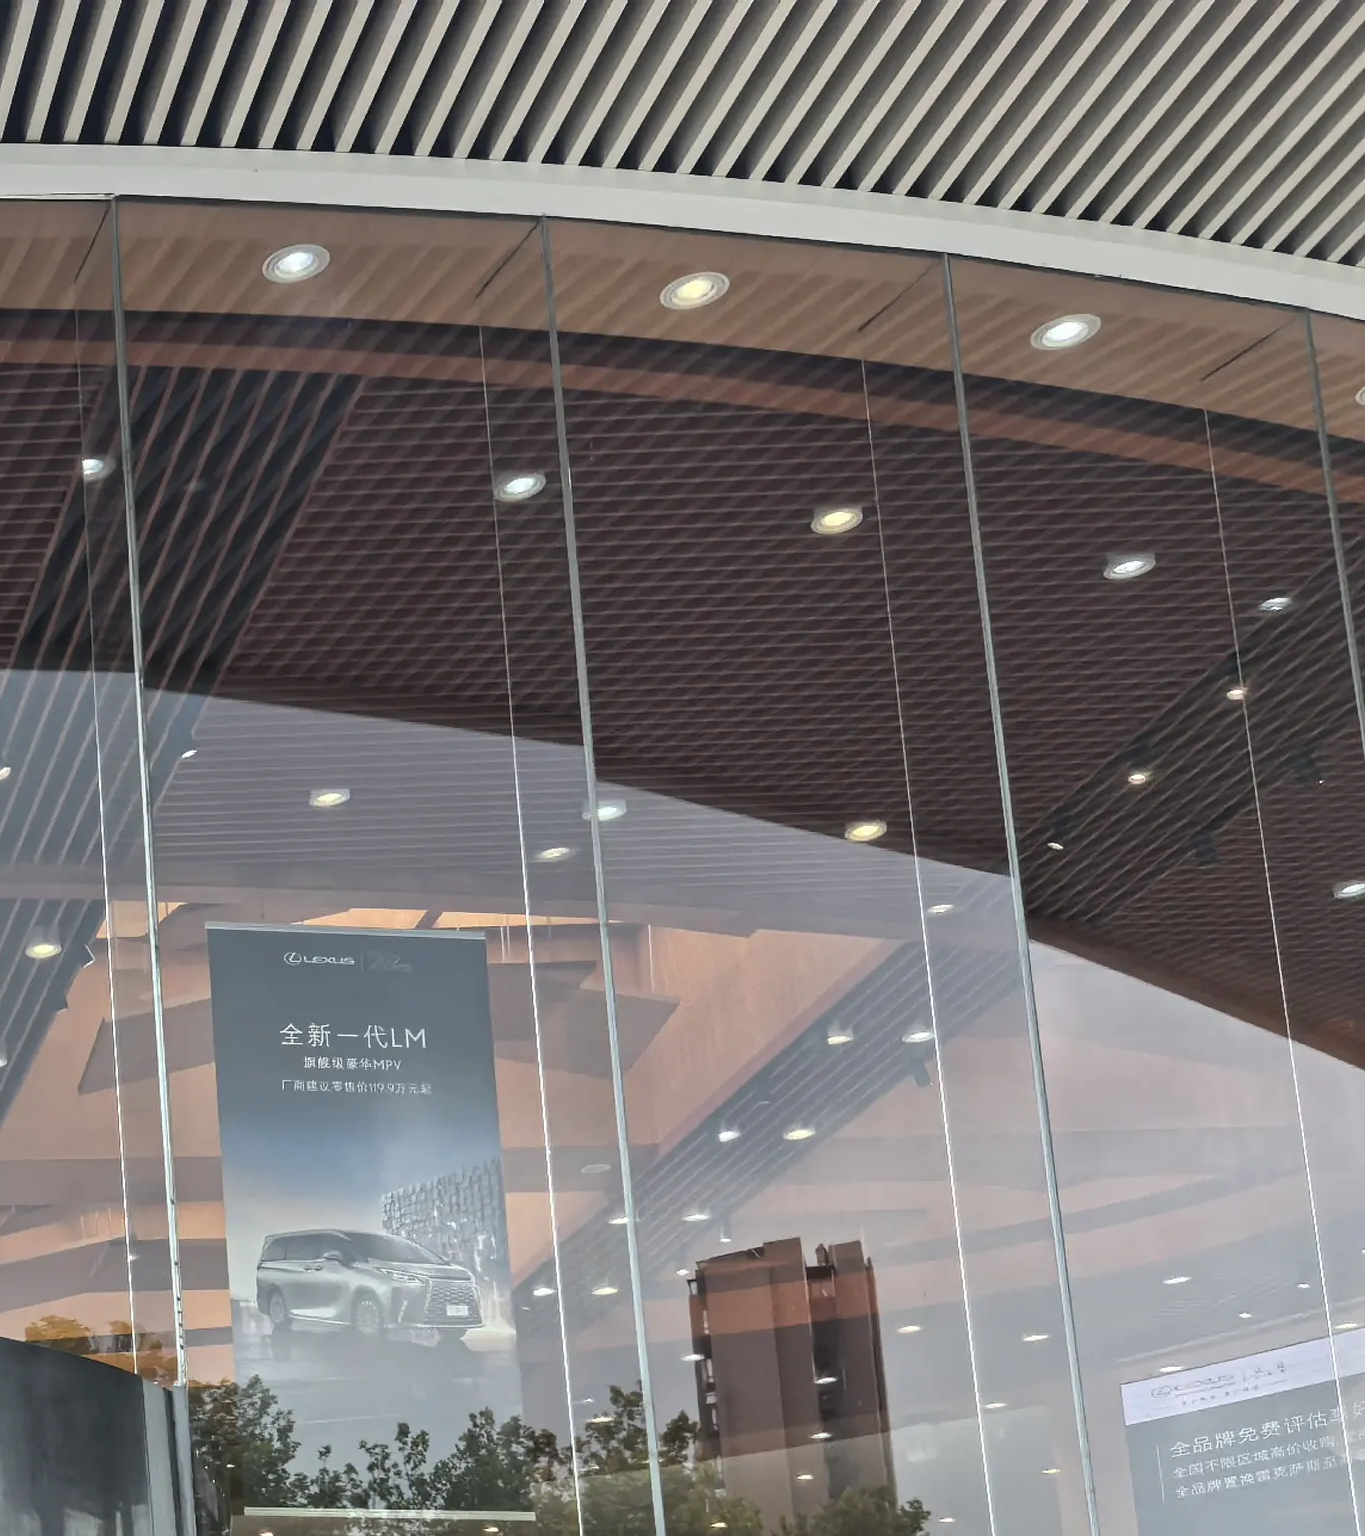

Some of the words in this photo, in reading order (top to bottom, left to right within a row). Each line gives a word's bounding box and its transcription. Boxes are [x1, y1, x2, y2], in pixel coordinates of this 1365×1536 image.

[303, 955, 355, 965] LEXUS
[280, 1022, 427, 1049] 全新一代LM
[303, 1056, 402, 1071] 旗舰级豪华MPV
